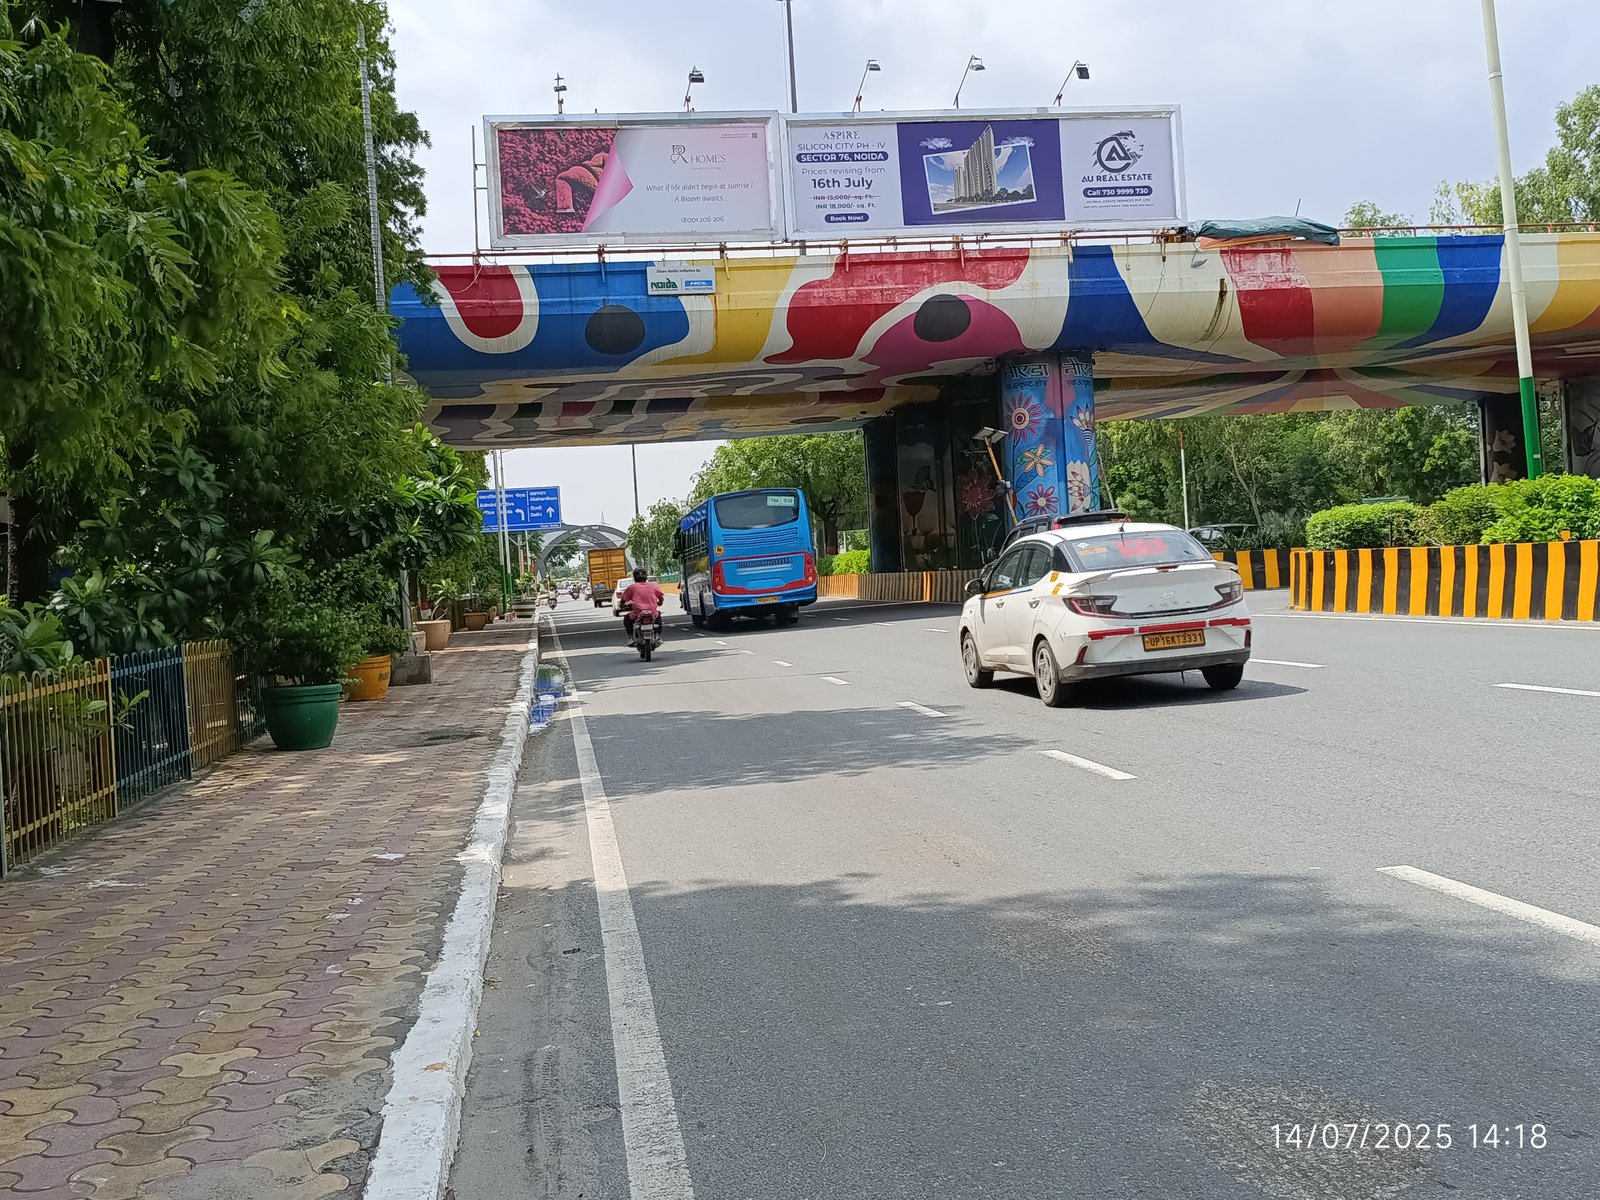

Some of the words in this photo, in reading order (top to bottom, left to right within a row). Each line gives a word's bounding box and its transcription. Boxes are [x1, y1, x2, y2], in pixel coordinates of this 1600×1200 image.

[822, 130, 861, 141] ASPIRE
[797, 143, 833, 151] SILICON
[834, 142, 855, 150] CITY
[856, 142, 869, 150] PH
[690, 154, 726, 164] HOMES
[801, 153, 837, 162] SECTOR
[838, 153, 852, 162] 76,
[853, 153, 885, 161] NOIDA
[801, 167, 828, 176] Prices
[829, 166, 863, 176] revising
[864, 166, 886, 174] from
[811, 177, 841, 189] 16th
[844, 176, 873, 190] July
[1081, 175, 1094, 183] AU
[1096, 174, 1120, 182] REAL
[1121, 173, 1153, 181] ESTATE
[646, 184, 664, 192] What
[664, 183, 671, 192] if
[670, 183, 681, 192] life
[681, 183, 700, 191] didn't
[700, 182, 718, 192] begin
[1116, 188, 1134, 196] 9999
[1135, 187, 1149, 195] 730
[1150, 633, 1202, 646] UP16KT3331
